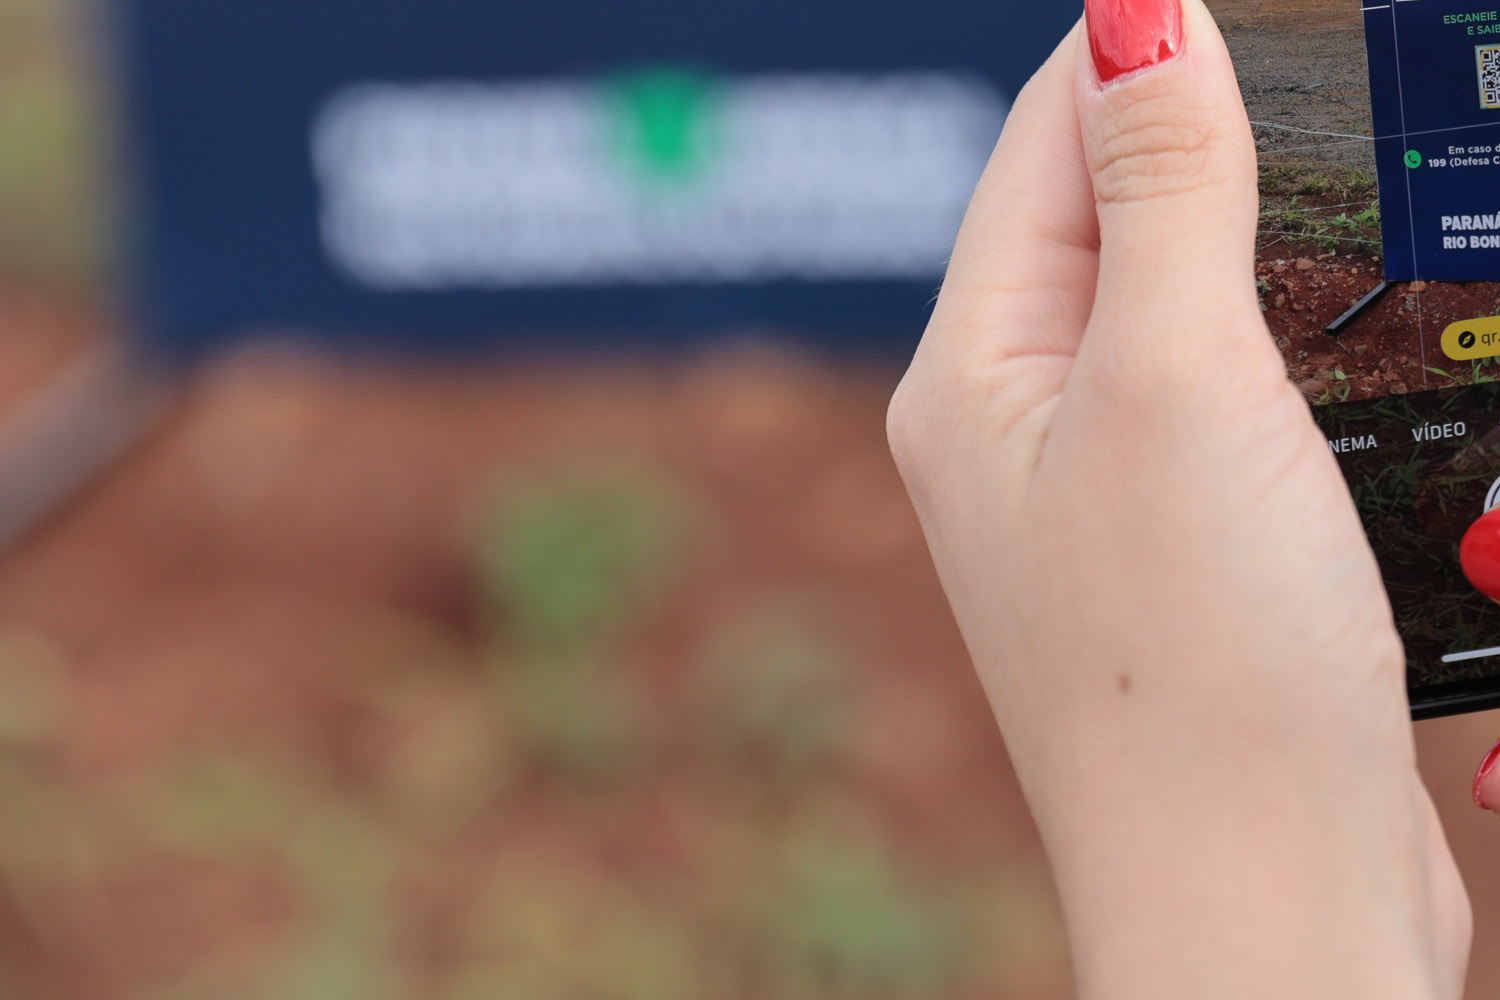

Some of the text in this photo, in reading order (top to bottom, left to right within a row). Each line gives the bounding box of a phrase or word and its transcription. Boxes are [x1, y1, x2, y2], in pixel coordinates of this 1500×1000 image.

[1443, 11, 1497, 25] ESCANEIE
[1467, 26, 1474, 36] E
[1448, 145, 1465, 155] Em
[1467, 145, 1492, 154] caso
[1428, 158, 1446, 168] 199
[1450, 156, 1490, 168] (Defesa
[1443, 235, 1467, 249] RIO
[1329, 434, 1378, 454] NEMA
[1411, 421, 1467, 442] VÍDEO
